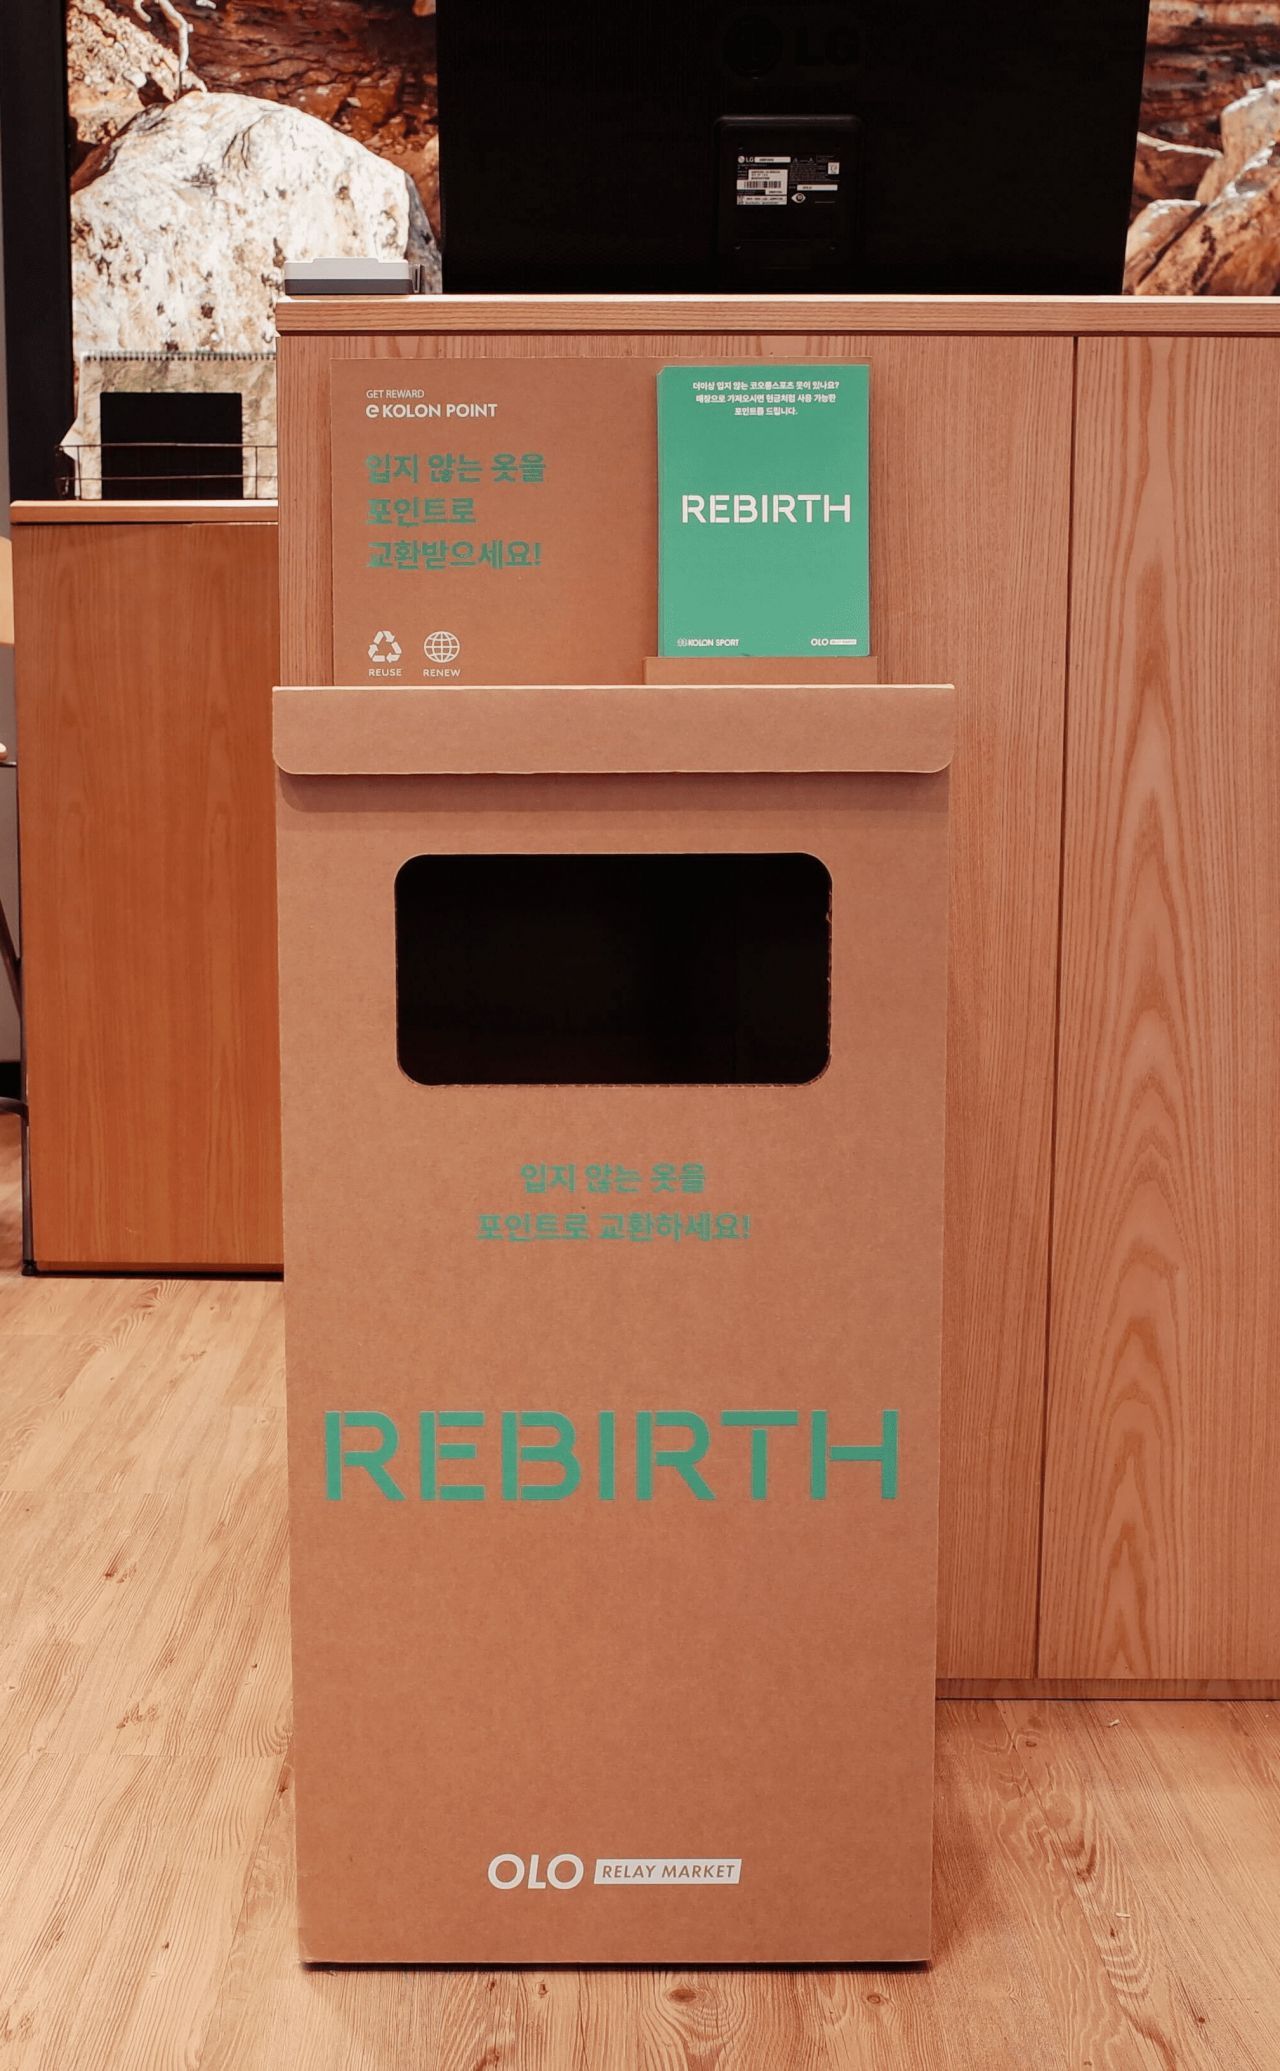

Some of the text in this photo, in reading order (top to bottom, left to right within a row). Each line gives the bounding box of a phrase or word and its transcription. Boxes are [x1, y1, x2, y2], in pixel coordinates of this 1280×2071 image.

[366, 389, 425, 399] GET REWARD
[692, 381, 840, 391] 더이상 입지 않는 코오롱스포츠 옷이 있나요?
[695, 394, 837, 404] 매장으로 가져오시면 현금처럼 사용 가능한
[446, 403, 498, 418] POINT
[734, 406, 799, 416] 포인트를 드립니다.
[366, 452, 546, 484] 입지 않는 옷을
[366, 496, 476, 527] 포인트로
[682, 494, 851, 524] REBIRTH
[366, 540, 542, 570] 교환받으세요!
[688, 638, 740, 647] KOLON SPORT
[810, 638, 829, 647] OLO
[368, 668, 461, 677] REUSE RENEW
[520, 1162, 706, 1194] 입지 않는 옷을
[476, 1211, 751, 1242] 포인트로 교환하세요!
[324, 1409, 899, 1501] REBIRTH
[487, 1853, 736, 1890] OLO RELAY MARKET
